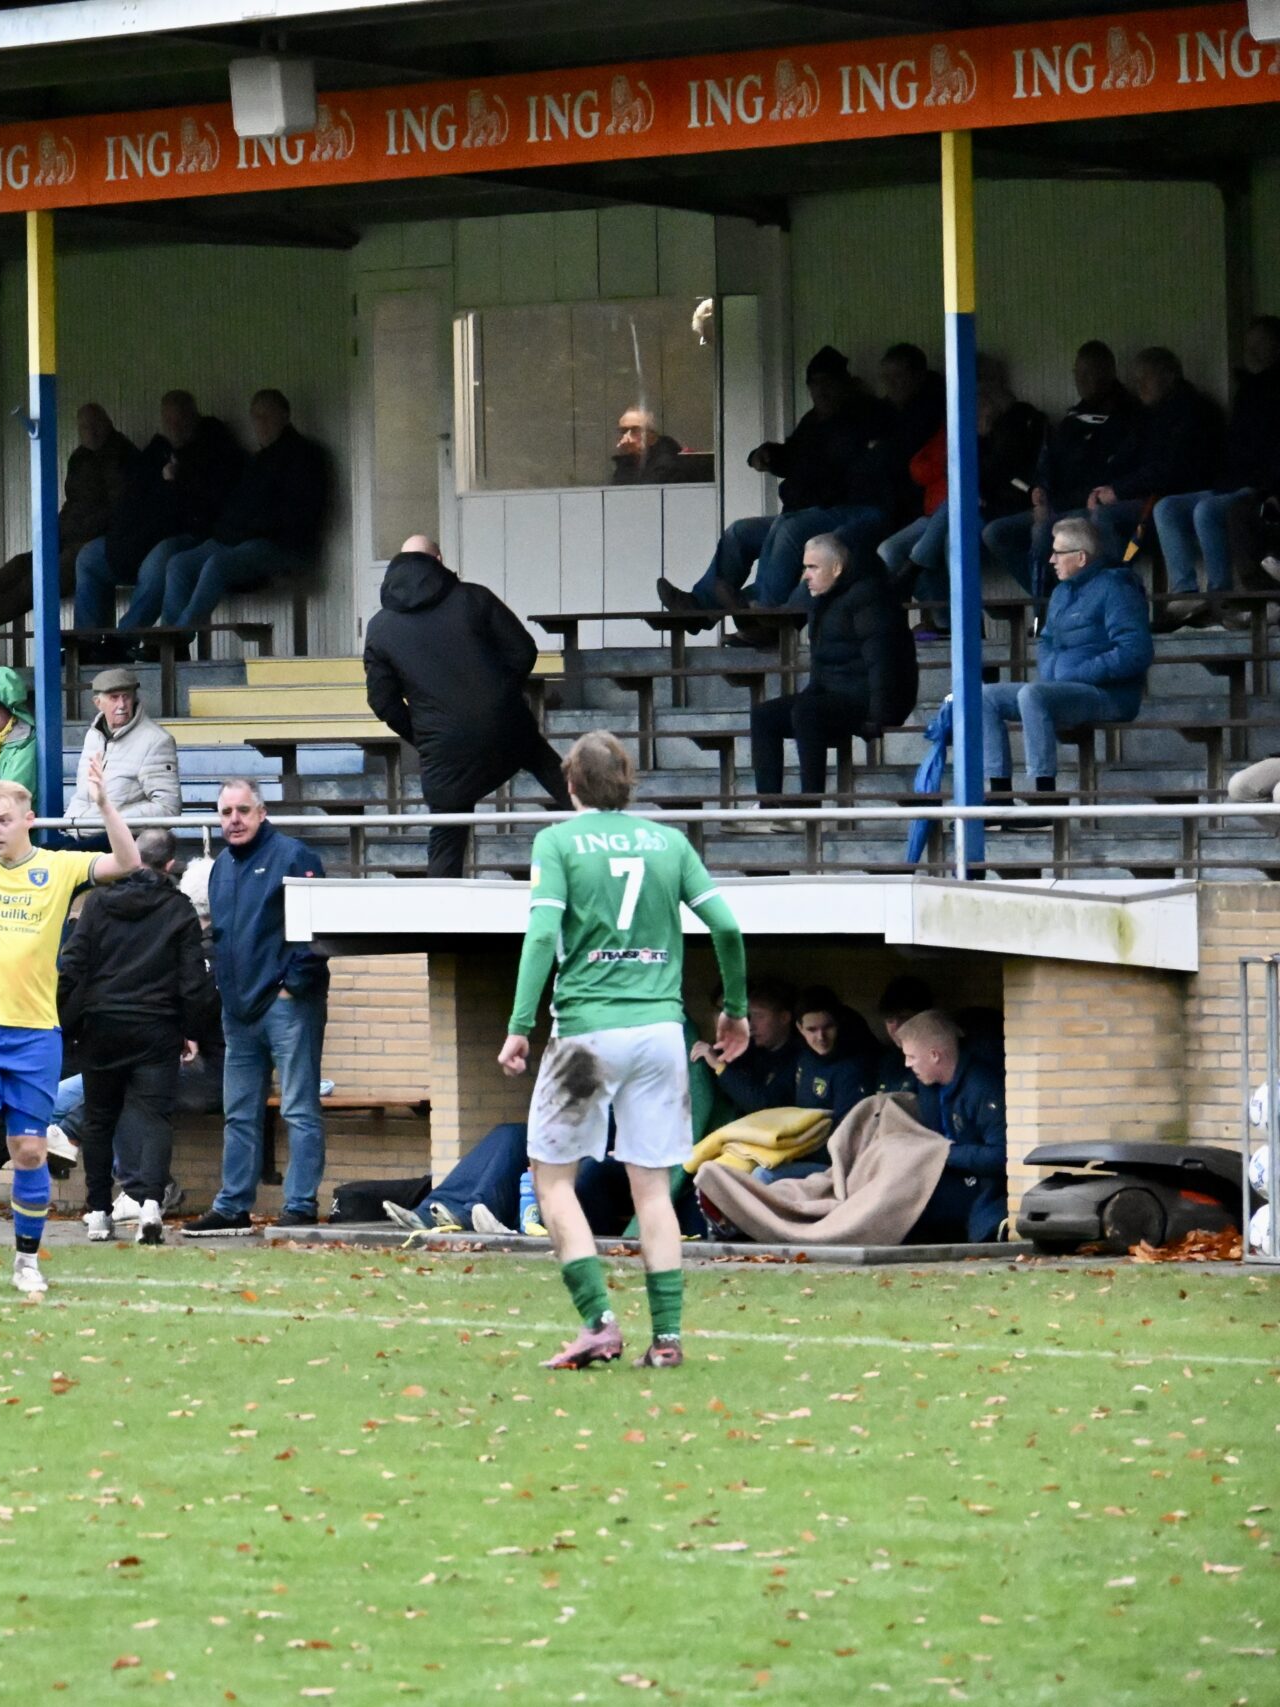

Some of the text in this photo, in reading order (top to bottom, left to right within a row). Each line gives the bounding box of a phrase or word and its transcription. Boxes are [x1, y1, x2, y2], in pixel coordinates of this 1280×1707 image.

[104, 132, 172, 181] ING
[385, 105, 456, 155] ING
[526, 91, 600, 142] ING
[687, 75, 764, 128] ING
[839, 61, 917, 114] ING
[1013, 43, 1096, 99] ING
[1176, 27, 1261, 83] ING
[572, 833, 630, 854] ING
[608, 857, 645, 930] 7
